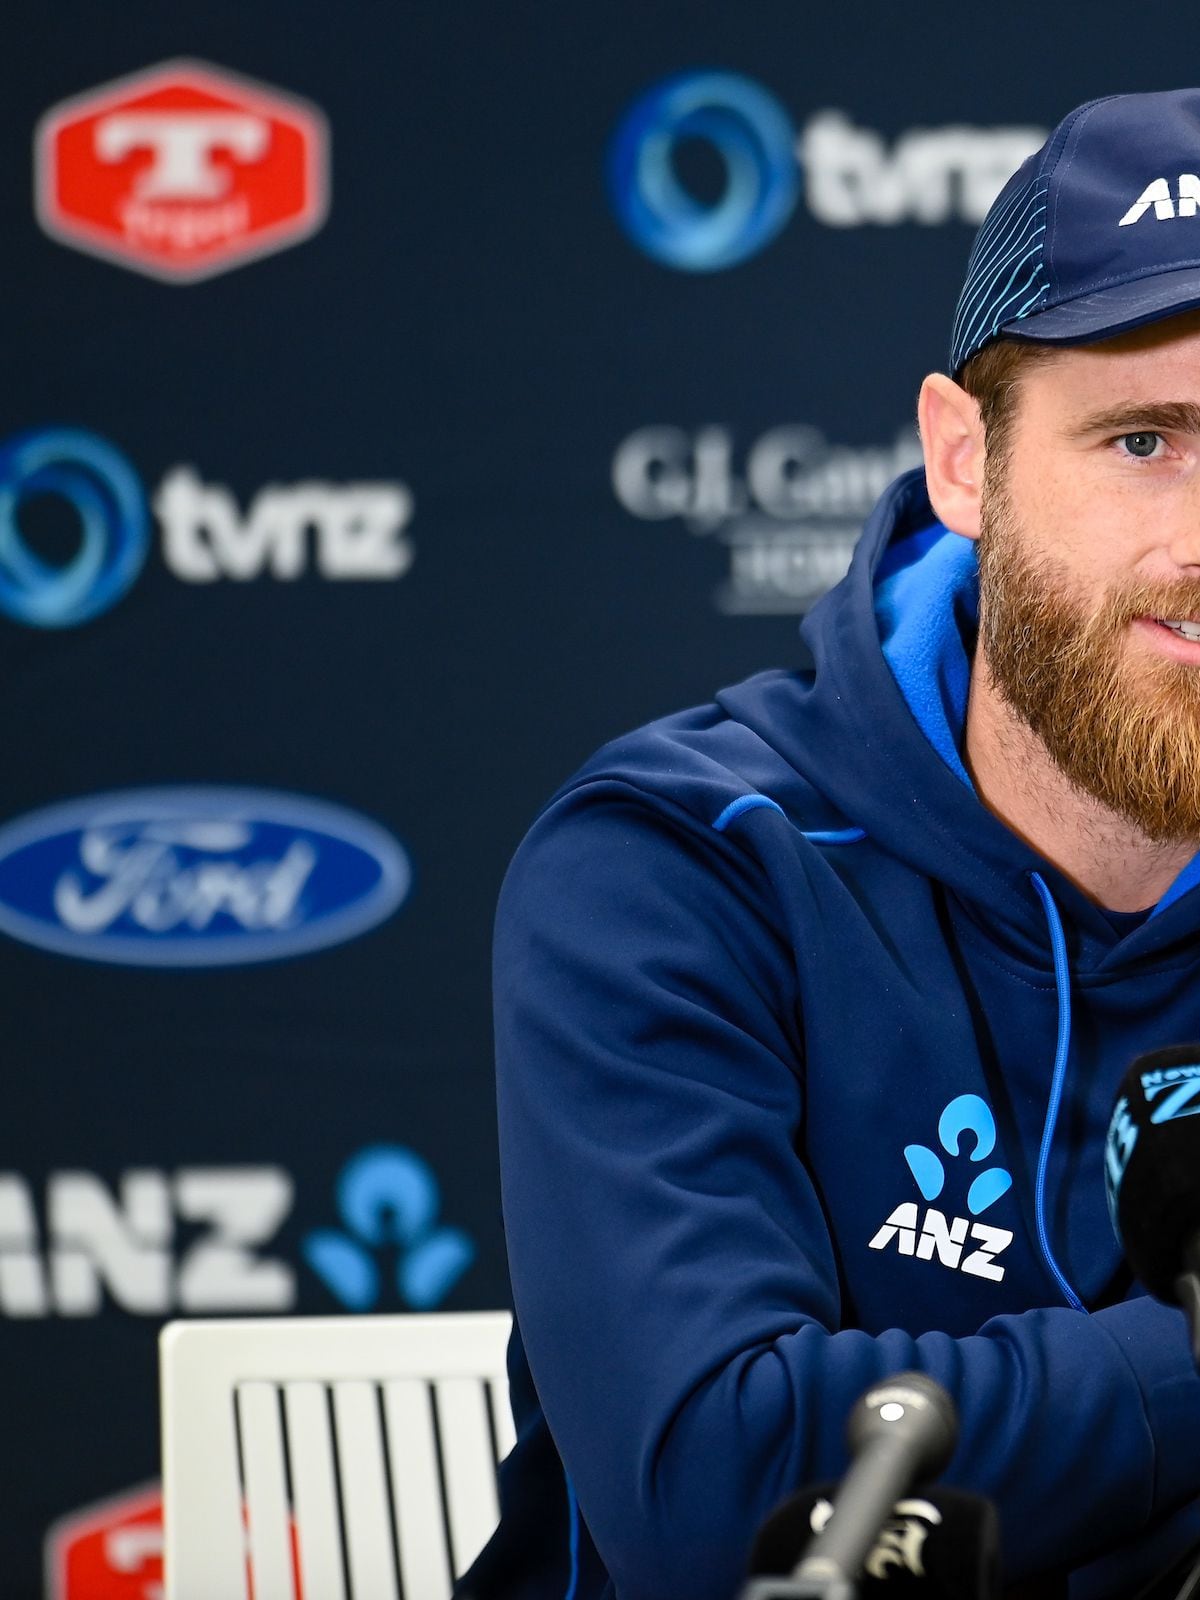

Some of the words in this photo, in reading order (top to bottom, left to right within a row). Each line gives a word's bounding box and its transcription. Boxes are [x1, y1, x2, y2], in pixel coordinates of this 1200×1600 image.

[154, 465, 414, 583] tvnz
[53, 820, 317, 934] Ford
[868, 1202, 1013, 1282] ANZ
